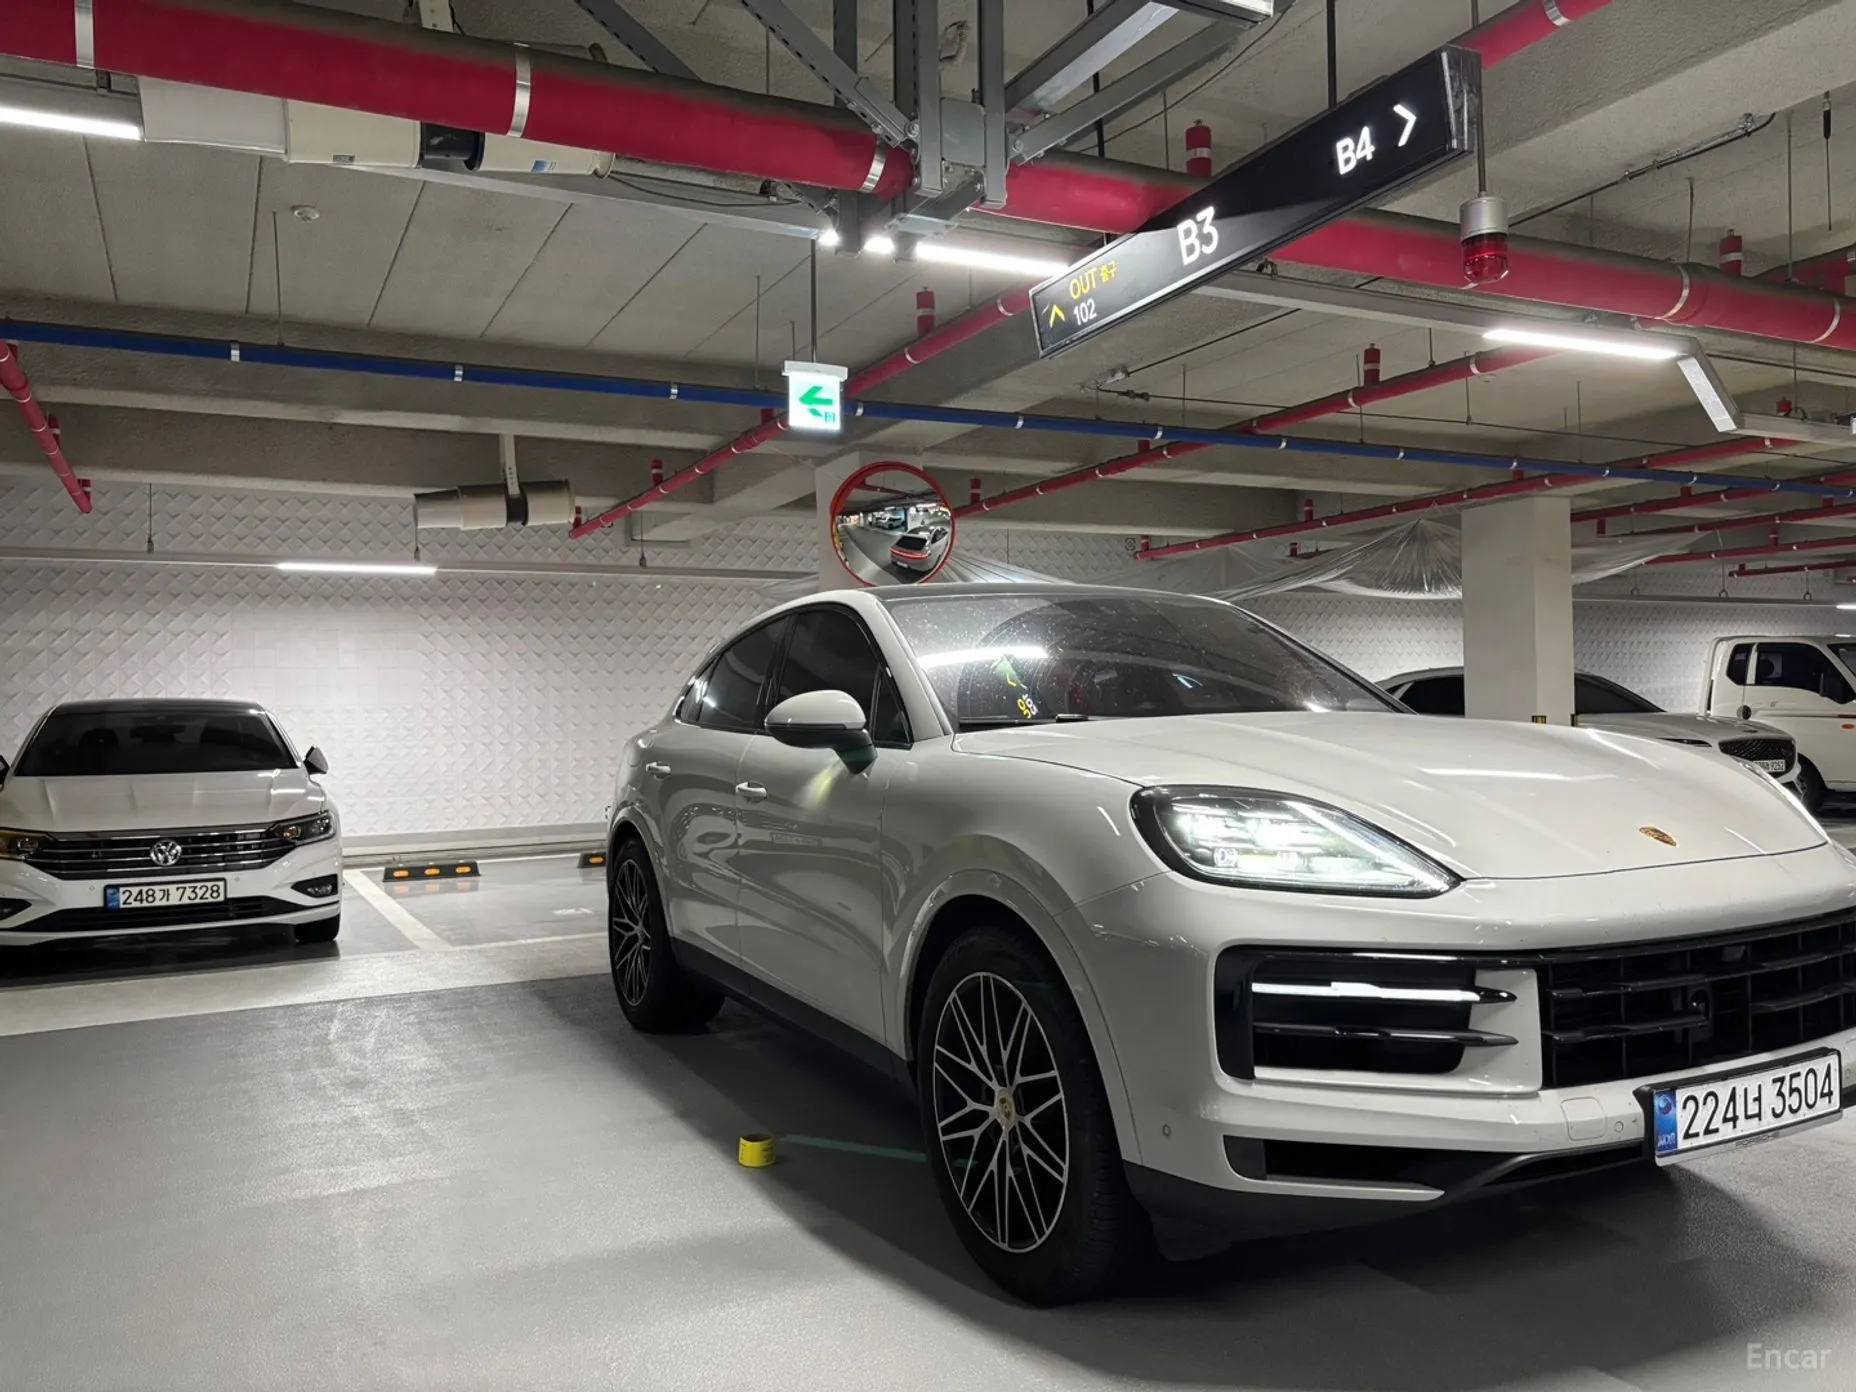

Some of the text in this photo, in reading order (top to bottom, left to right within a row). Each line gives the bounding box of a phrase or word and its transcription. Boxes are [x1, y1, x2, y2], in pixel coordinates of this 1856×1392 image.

[1336, 125, 1376, 175] B4
[1176, 205, 1219, 266] B3
[1069, 267, 1098, 300] OUT
[1073, 297, 1098, 326] 102
[121, 883, 221, 906] 248가 7328
[1682, 1062, 1835, 1140] 224너 3504
